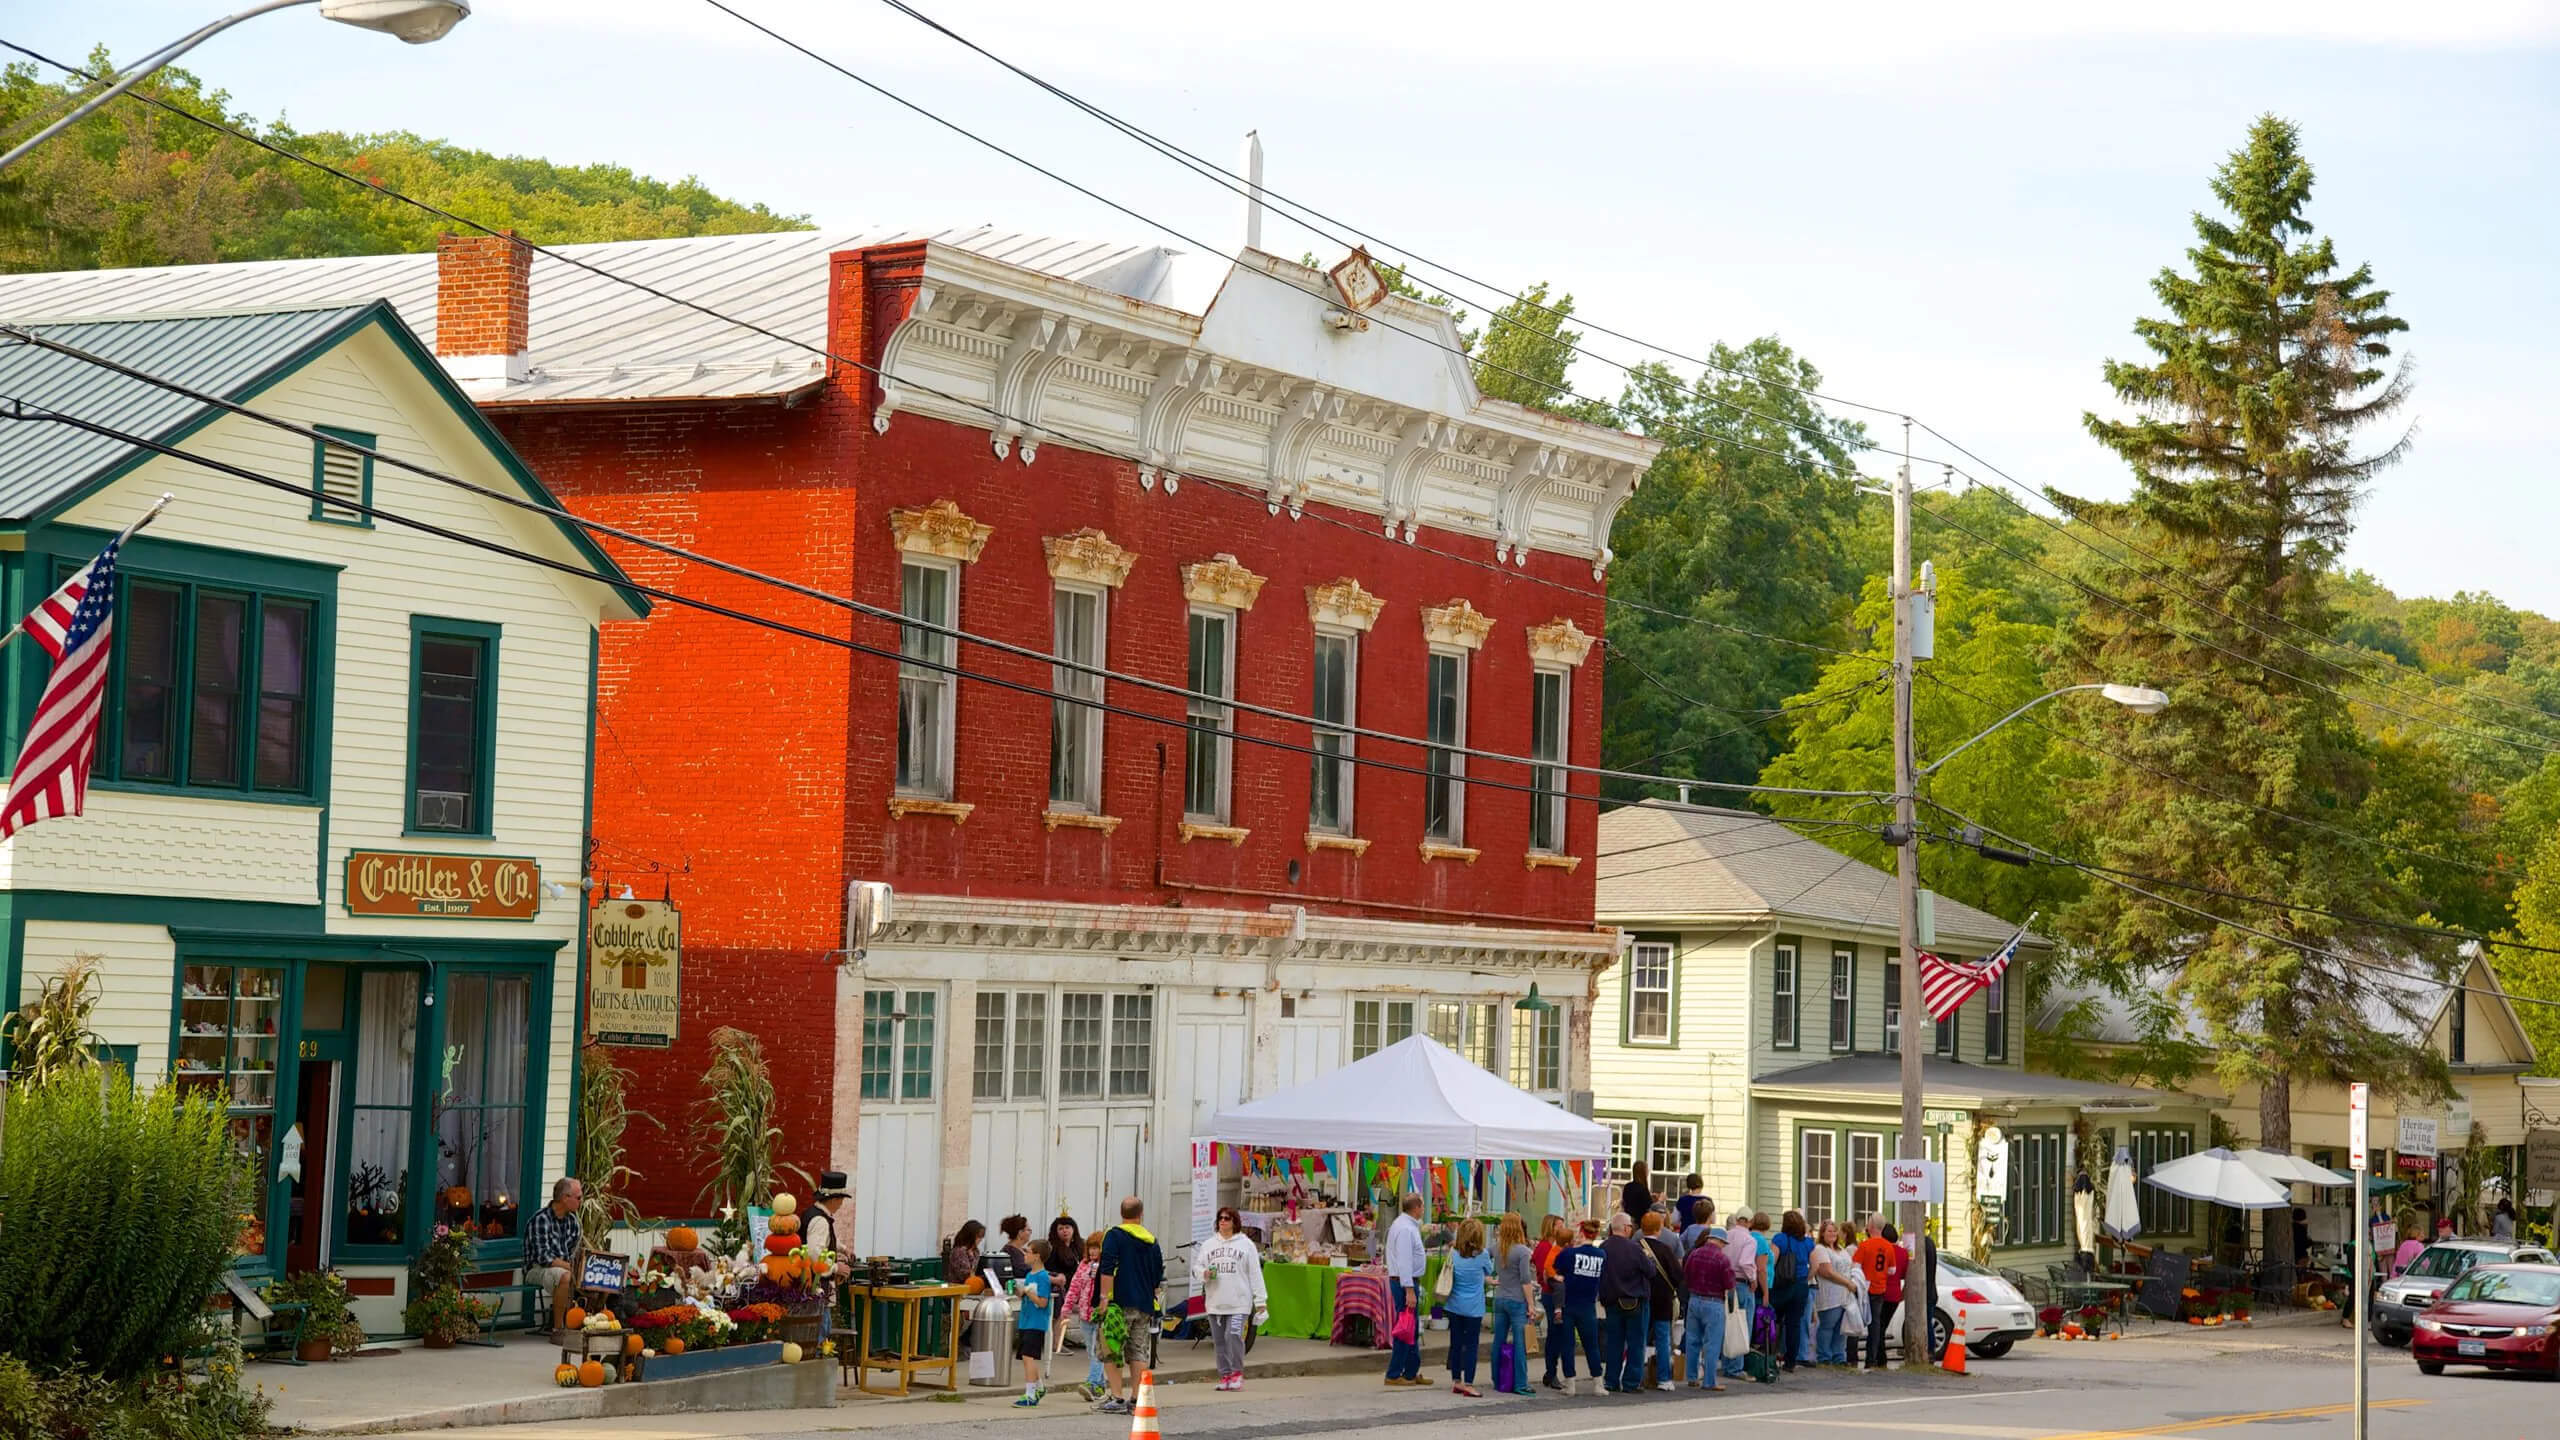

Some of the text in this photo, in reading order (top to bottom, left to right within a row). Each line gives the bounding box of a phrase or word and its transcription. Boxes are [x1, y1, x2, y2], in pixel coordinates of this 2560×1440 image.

[360, 857, 533, 907] Cobbler & Co.
[424, 904, 469, 913] Est. 1997
[594, 922, 644, 948] Cobbler
[646, 926, 656, 948] &
[592, 988, 620, 1009] GIFTS
[622, 993, 629, 1010] &
[2402, 1118, 2435, 1132] Heritage
[2405, 1129, 2431, 1144] Living
[2399, 1157, 2436, 1169] ANTIQUES
[1892, 1166, 1923, 1179] Shuttle
[1898, 1181, 1917, 1197] Stop
[587, 1254, 611, 1269] Come
[1207, 1247, 1245, 1263] AMERICAN
[1574, 1253, 1604, 1272] FDNY
[1875, 1252, 1886, 1273] 8
[584, 1271, 621, 1288] OPEN
